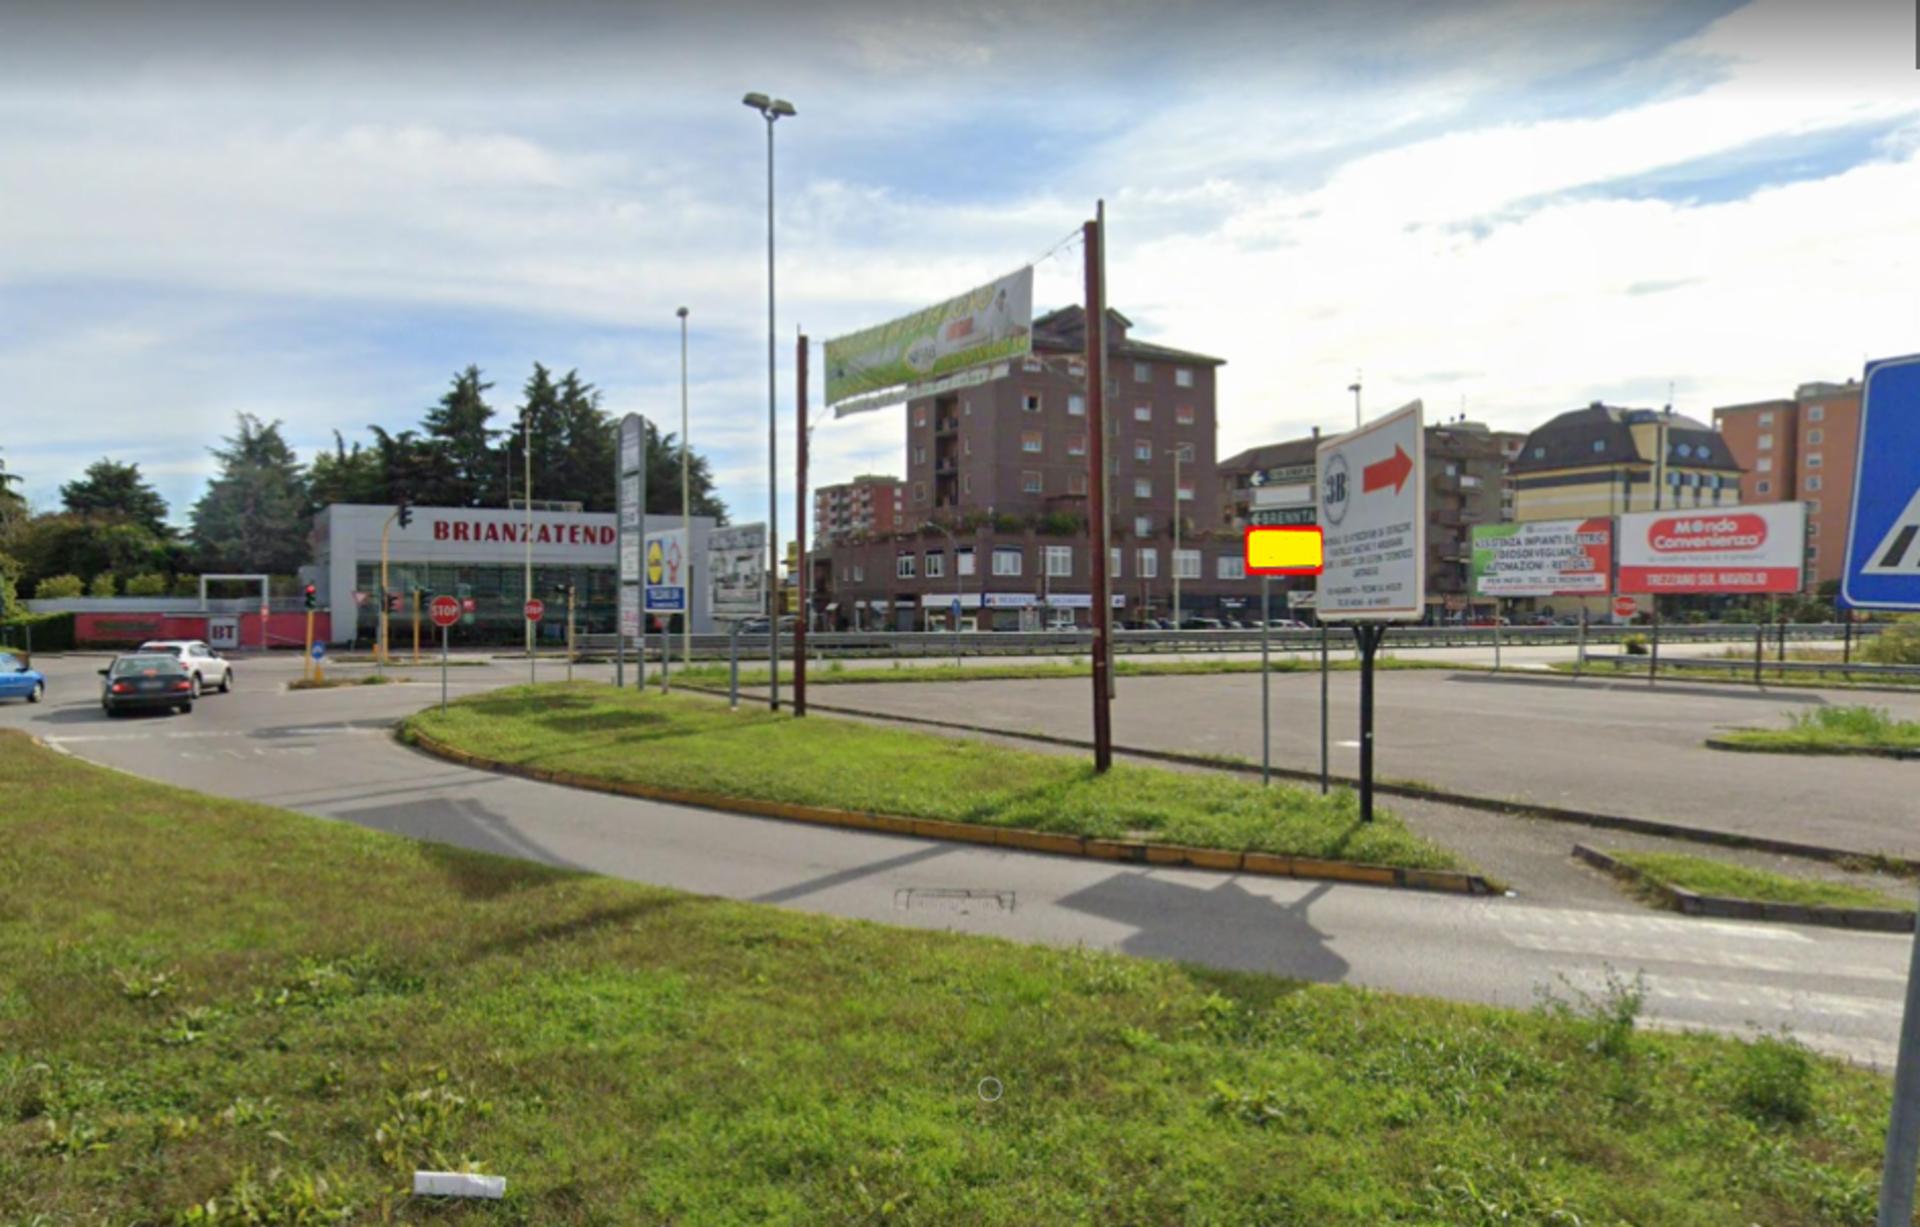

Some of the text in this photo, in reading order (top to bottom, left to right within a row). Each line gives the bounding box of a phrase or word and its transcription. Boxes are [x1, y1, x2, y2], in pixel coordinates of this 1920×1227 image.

[1326, 472, 1346, 505] 3B
[1675, 517, 1737, 534] Mondo
[1654, 534, 1759, 549] Convenienza
[1494, 547, 1585, 559] DEOSORVEGLIANZA
[431, 606, 458, 617] STOP
[212, 625, 235, 639] BT
